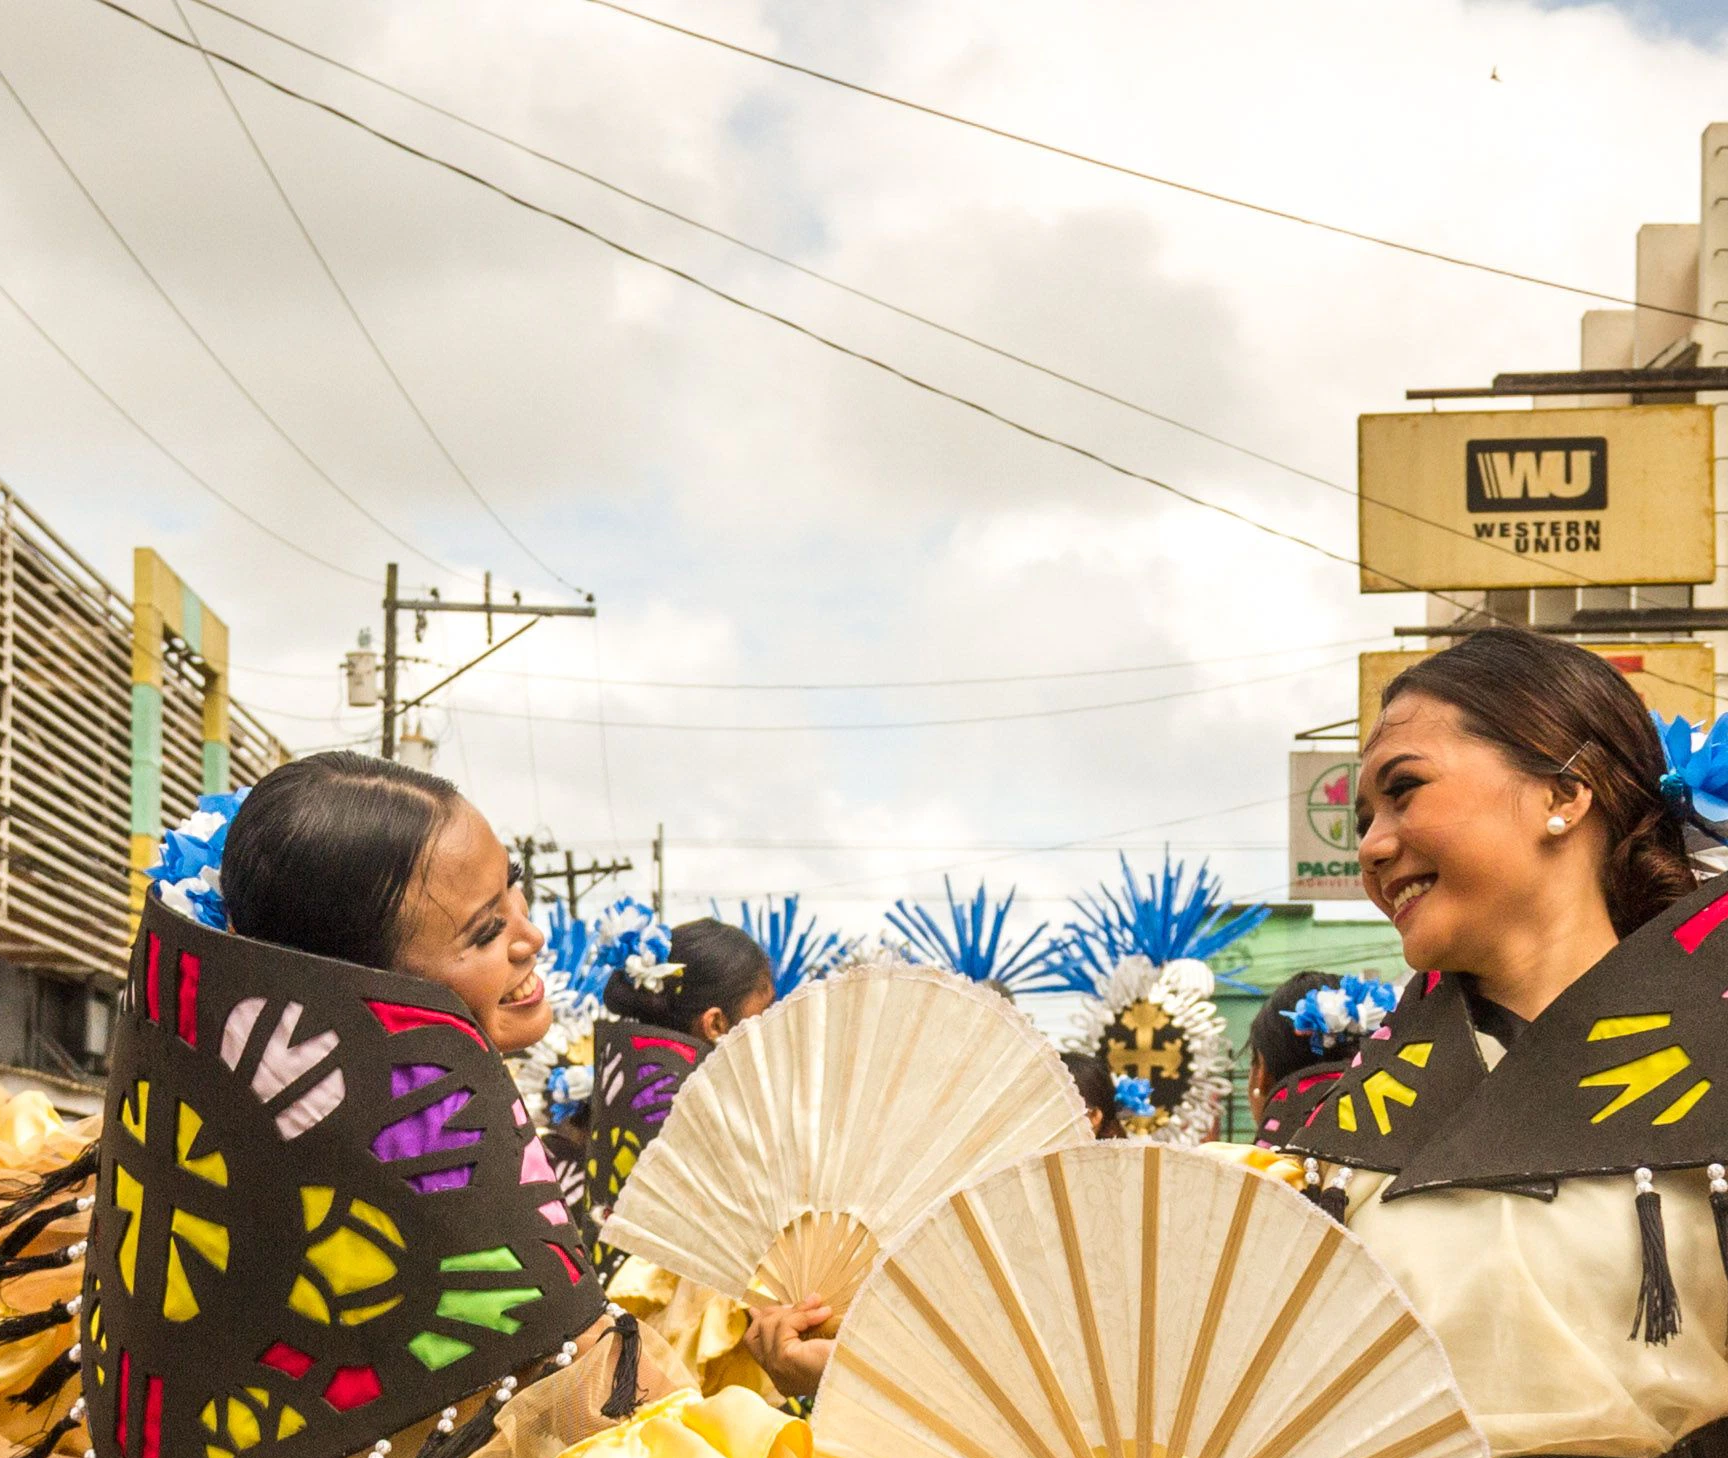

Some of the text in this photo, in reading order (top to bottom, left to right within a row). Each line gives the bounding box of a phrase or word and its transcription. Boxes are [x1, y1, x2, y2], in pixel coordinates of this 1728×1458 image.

[1477, 450, 1593, 499] WU
[1474, 520, 1601, 538] WESTERN
[1515, 536, 1601, 553] UNION
